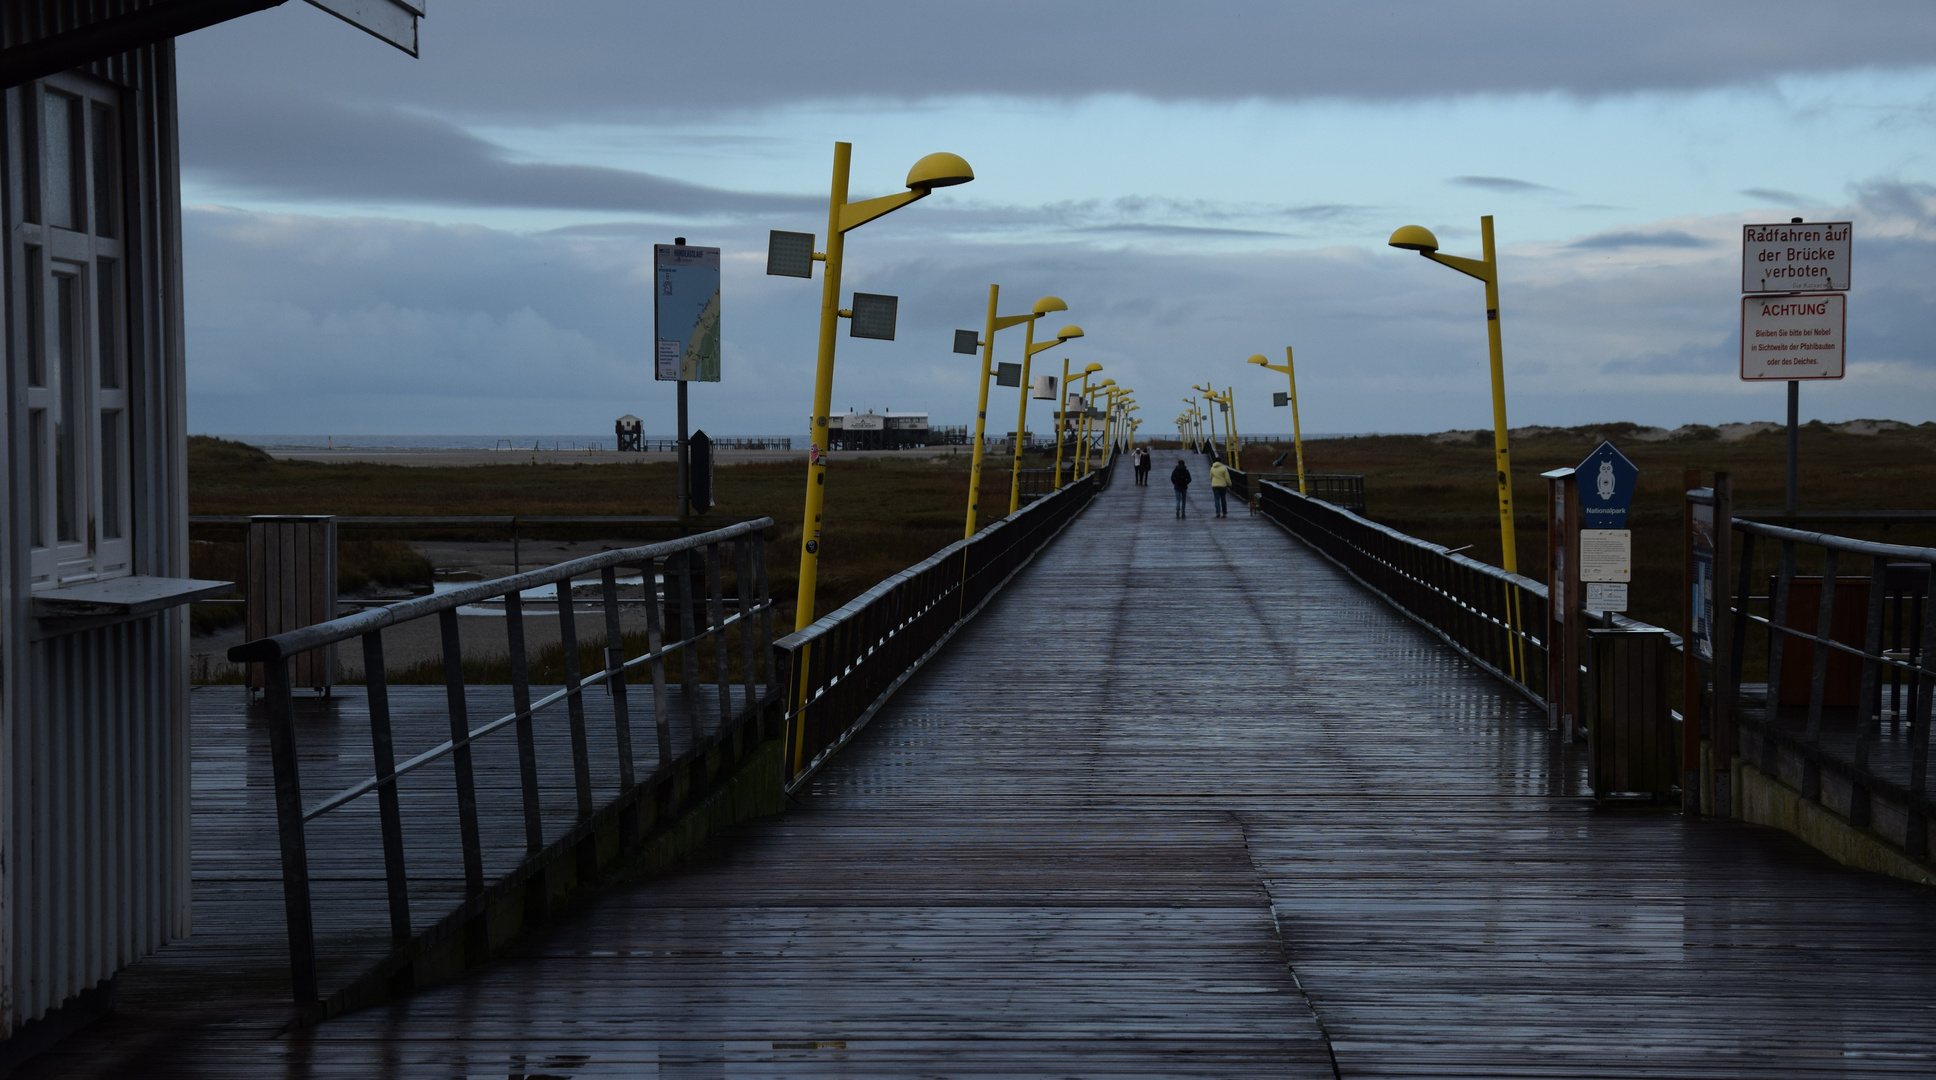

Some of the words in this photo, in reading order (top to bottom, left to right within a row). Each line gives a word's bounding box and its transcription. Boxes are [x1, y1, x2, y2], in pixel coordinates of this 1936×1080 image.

[1747, 228, 1820, 242] Radfahren
[1824, 227, 1848, 241] auf
[1758, 248, 1781, 262] der
[1786, 246, 1835, 261] Brücke
[1765, 264, 1828, 278] verboten
[1761, 303, 1827, 317] ACHTUNG
[1755, 329, 1778, 337] Bleiben
[1778, 329, 1788, 337] Sie
[1789, 328, 1803, 337] bitte
[1803, 328, 1813, 336] bei
[1813, 327, 1831, 336] Nebel
[1751, 344, 1757, 352] in
[1758, 343, 1788, 352] Sichtweite
[1789, 342, 1799, 351] der
[1800, 342, 1836, 351] Pfahlbauten
[1767, 358, 1781, 366] oder
[1781, 358, 1792, 366] des
[1793, 357, 1819, 365] Deiches.
[1586, 507, 1626, 515] Nationalpark
